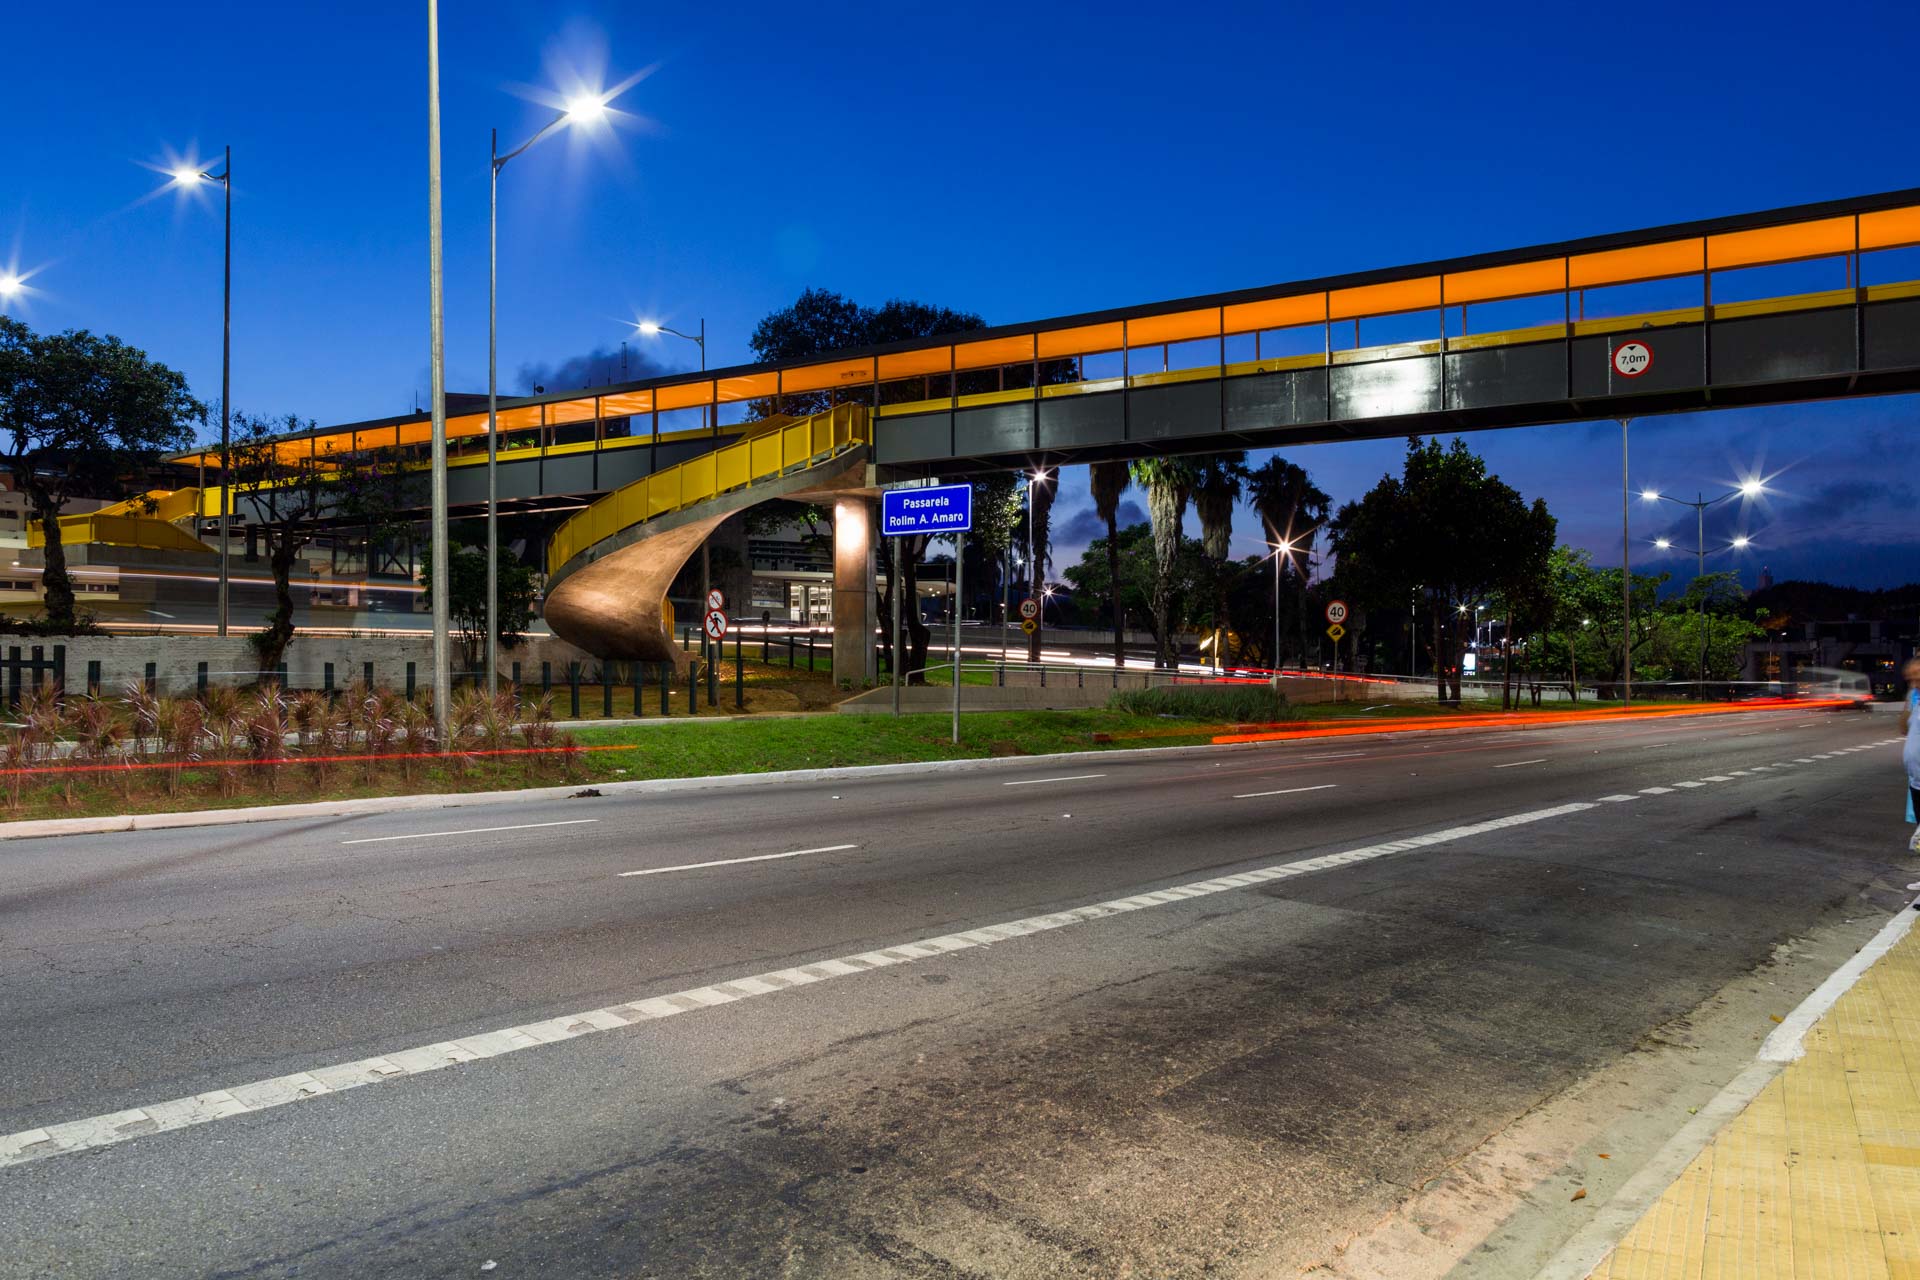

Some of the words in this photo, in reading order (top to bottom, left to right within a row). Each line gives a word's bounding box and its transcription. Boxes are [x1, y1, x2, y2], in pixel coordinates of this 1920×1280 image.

[1621, 354, 1646, 365] 7,0m
[903, 496, 950, 509] Passarela
[889, 515, 916, 527] Rolim
[919, 513, 929, 525] A.
[931, 512, 964, 524] Amaro
[1023, 603, 1036, 614] 40
[1330, 606, 1345, 617] 40
